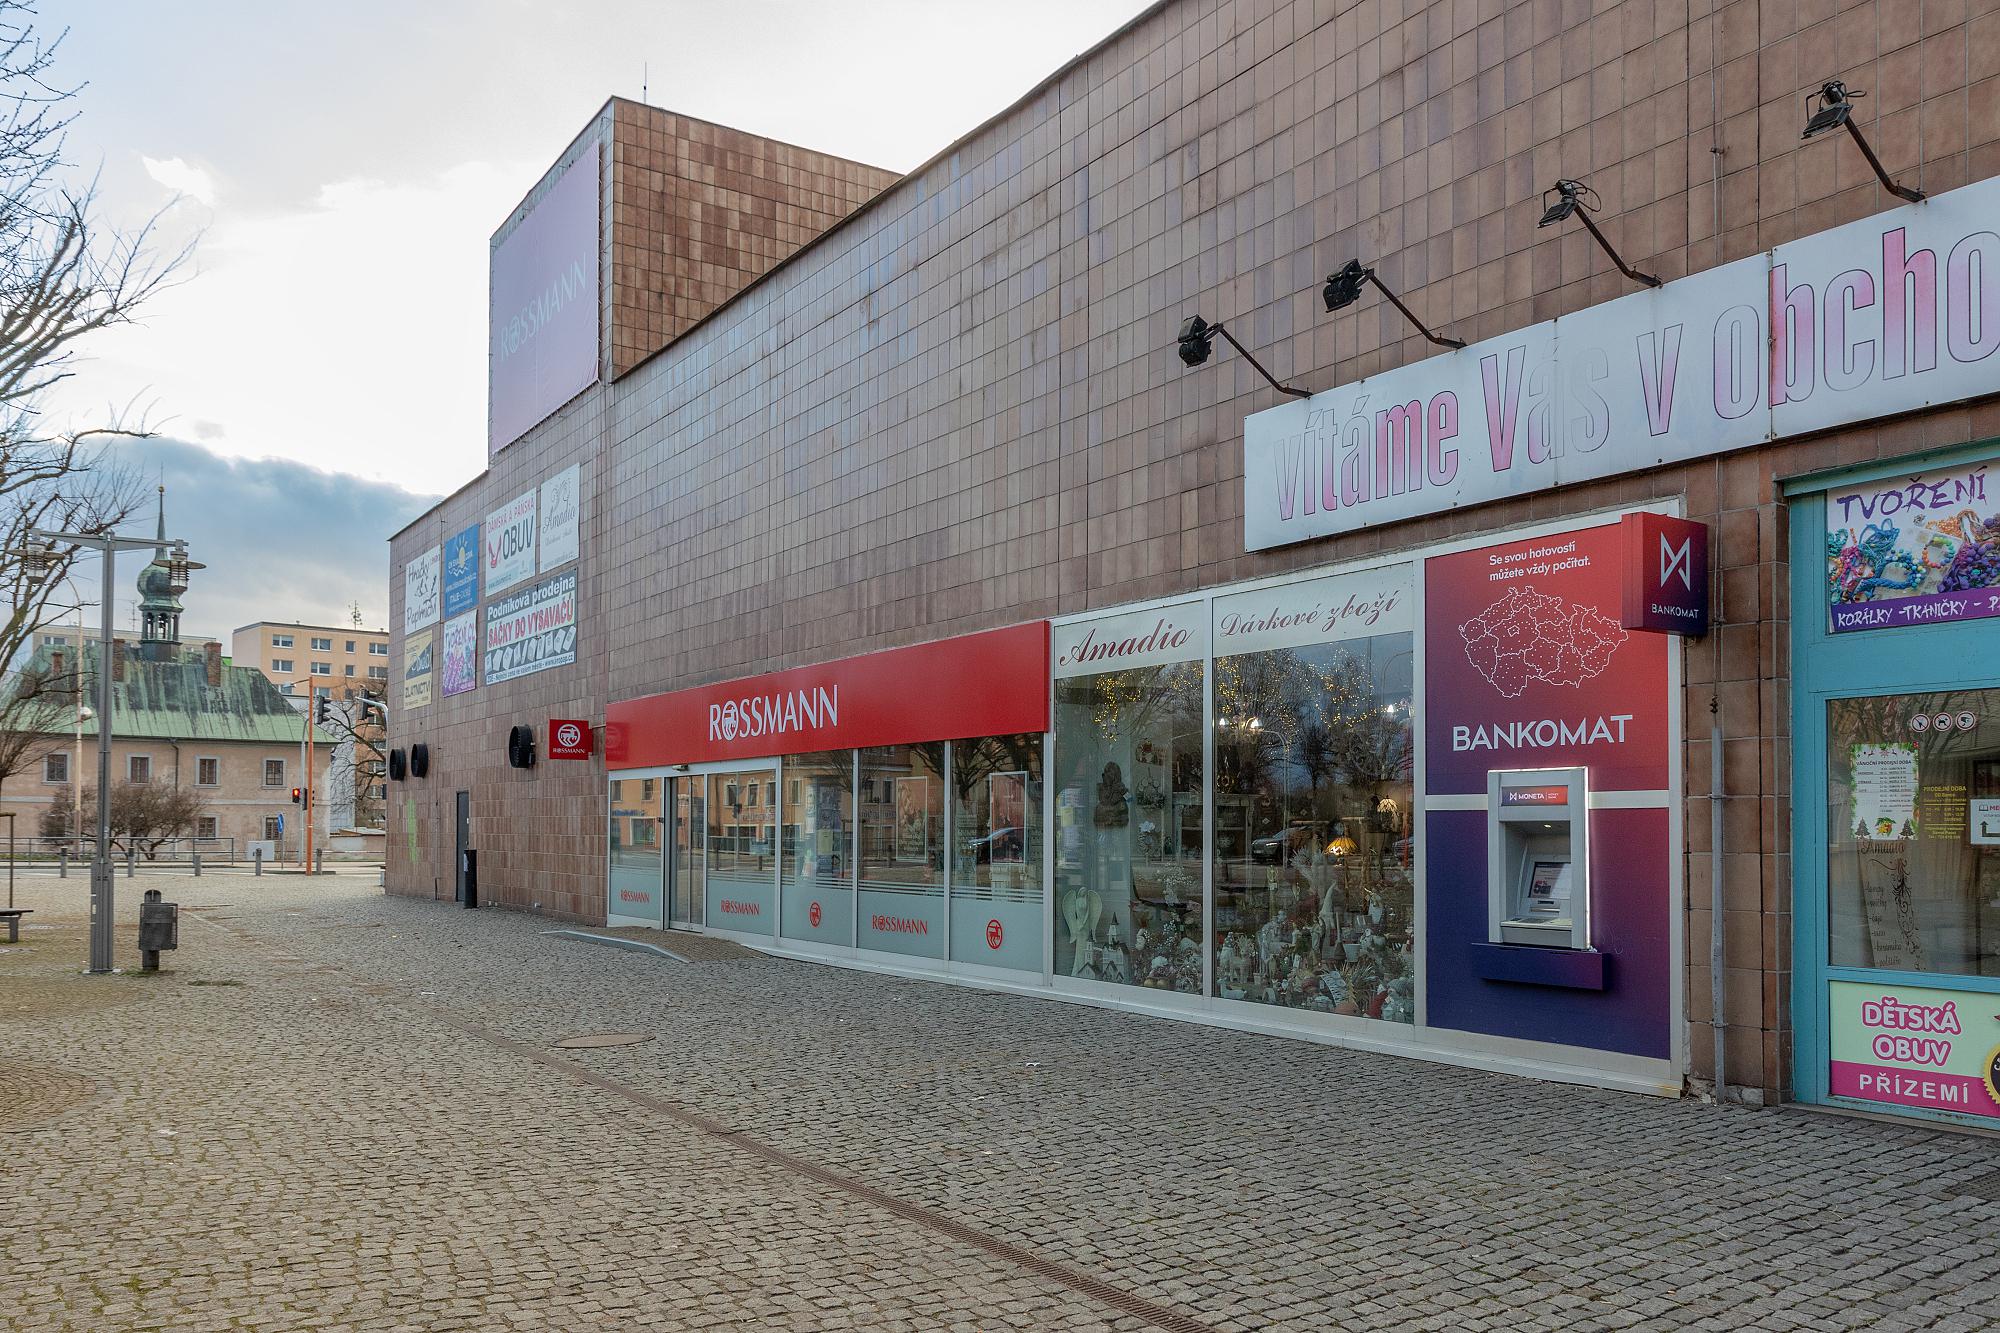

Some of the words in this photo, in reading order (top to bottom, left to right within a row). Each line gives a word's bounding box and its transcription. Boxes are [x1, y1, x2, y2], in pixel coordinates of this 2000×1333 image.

[501, 252, 586, 361] ROSSMANN
[1273, 391, 1459, 522] vítáme
[1480, 338, 1609, 472] Vás
[1636, 322, 1683, 437] v
[1837, 465, 1988, 524] TVOŘENÍ
[502, 515, 534, 560] OBUV
[1489, 555, 1503, 566] Se
[1504, 552, 1527, 564] svou
[1529, 541, 1576, 559] hotovostí
[1489, 567, 1524, 581] můžete
[1526, 562, 1550, 576] vždy
[1552, 556, 1591, 572] počítat.
[487, 591, 530, 621] Podniková
[532, 576, 575, 606] prodejna
[1220, 603, 1324, 637] Dárkové
[1320, 590, 1401, 633] zboží
[1651, 603, 1700, 619] BANKOMAT
[488, 620, 514, 649] SÁČKY
[514, 616, 526, 639] DO
[1838, 607, 1893, 627] KORÁLKY
[1059, 618, 1195, 667] Amadio
[709, 684, 838, 742] ROSSMANN
[1452, 714, 1633, 752] BANKOMAT
[620, 889, 650, 904] ROSSMANN
[720, 899, 760, 916] ROSSMANN
[871, 914, 928, 935] ROSSMANN
[1863, 997, 1960, 1033] DĚTSKÁ
[1873, 1035, 1950, 1065] OBUV
[1859, 1071, 1968, 1104] PŘÍZEMÍ
